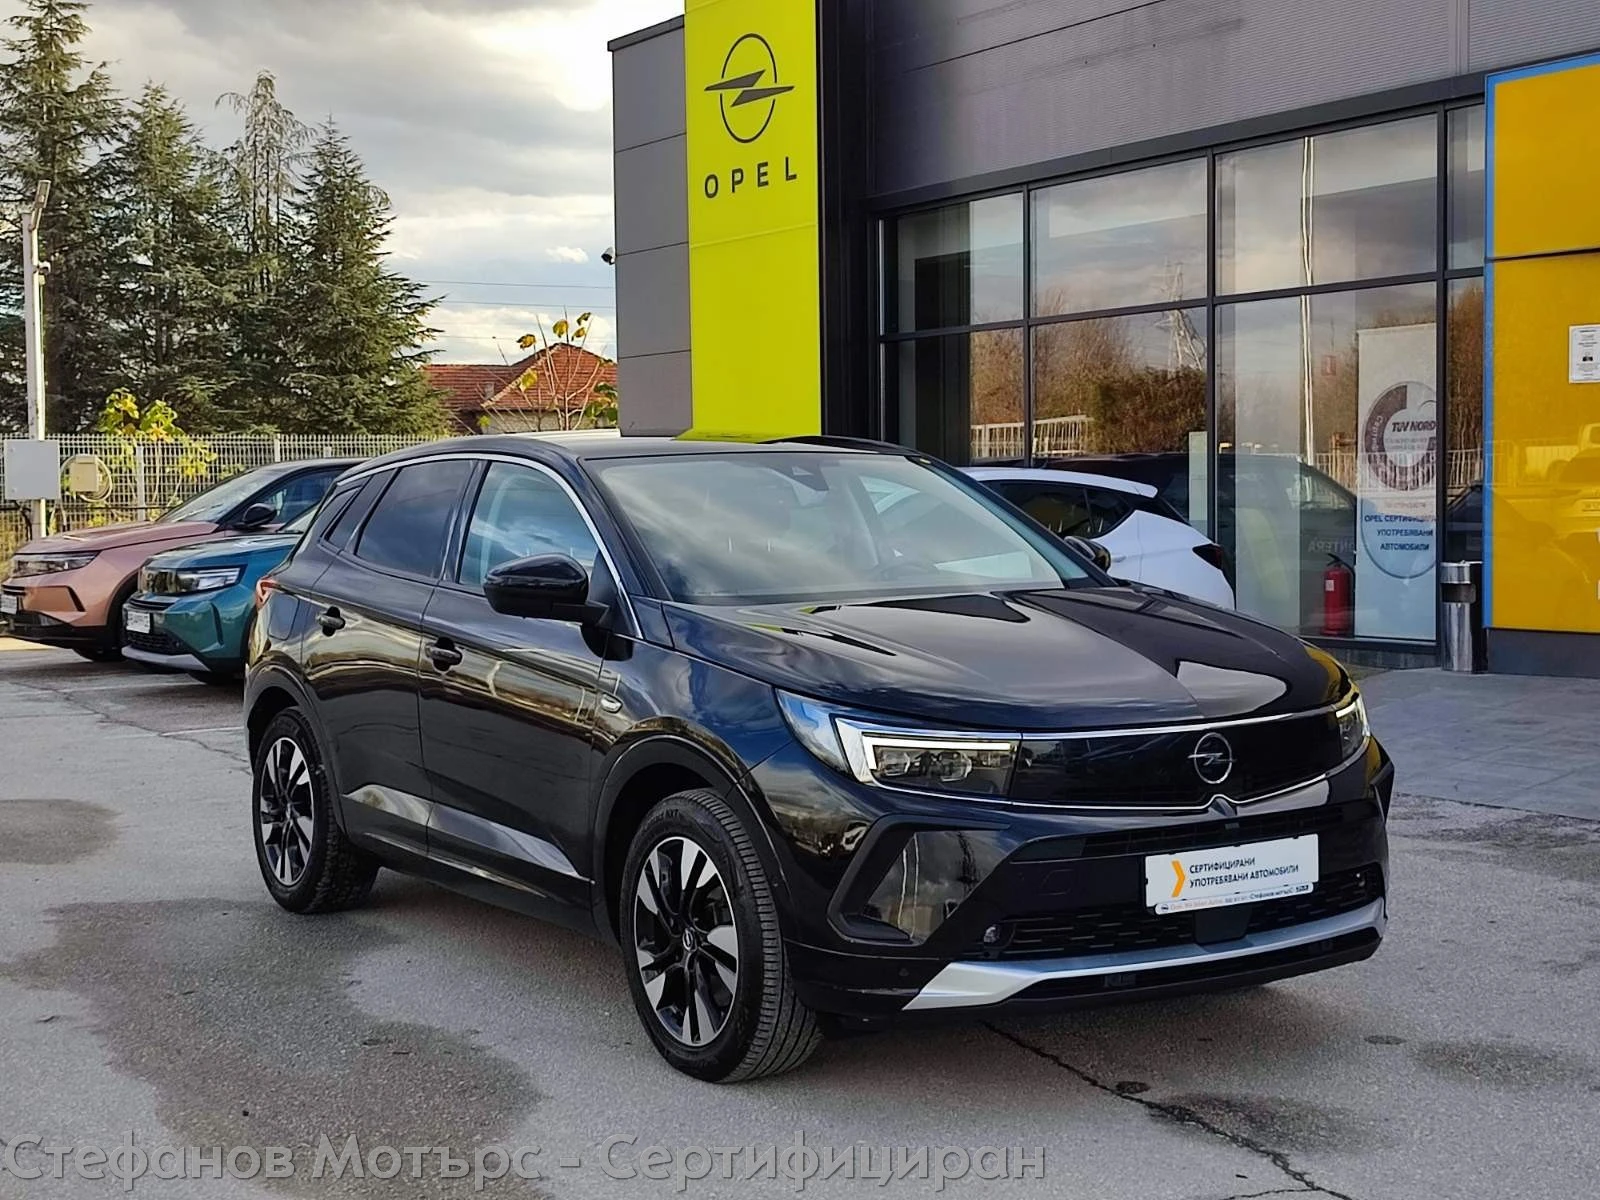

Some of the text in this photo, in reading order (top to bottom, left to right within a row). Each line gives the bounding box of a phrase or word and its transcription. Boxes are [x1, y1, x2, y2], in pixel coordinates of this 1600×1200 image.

[704, 156, 797, 199] OPEL
[1409, 420, 1437, 431] NORD
[1364, 514, 1383, 522] OPEL
[1189, 857, 1256, 874] СЕРТИФИЦИРАНИ
[1189, 864, 1299, 888] УПОТРЕБЯВАНИ АВТОМОБИЛИ
